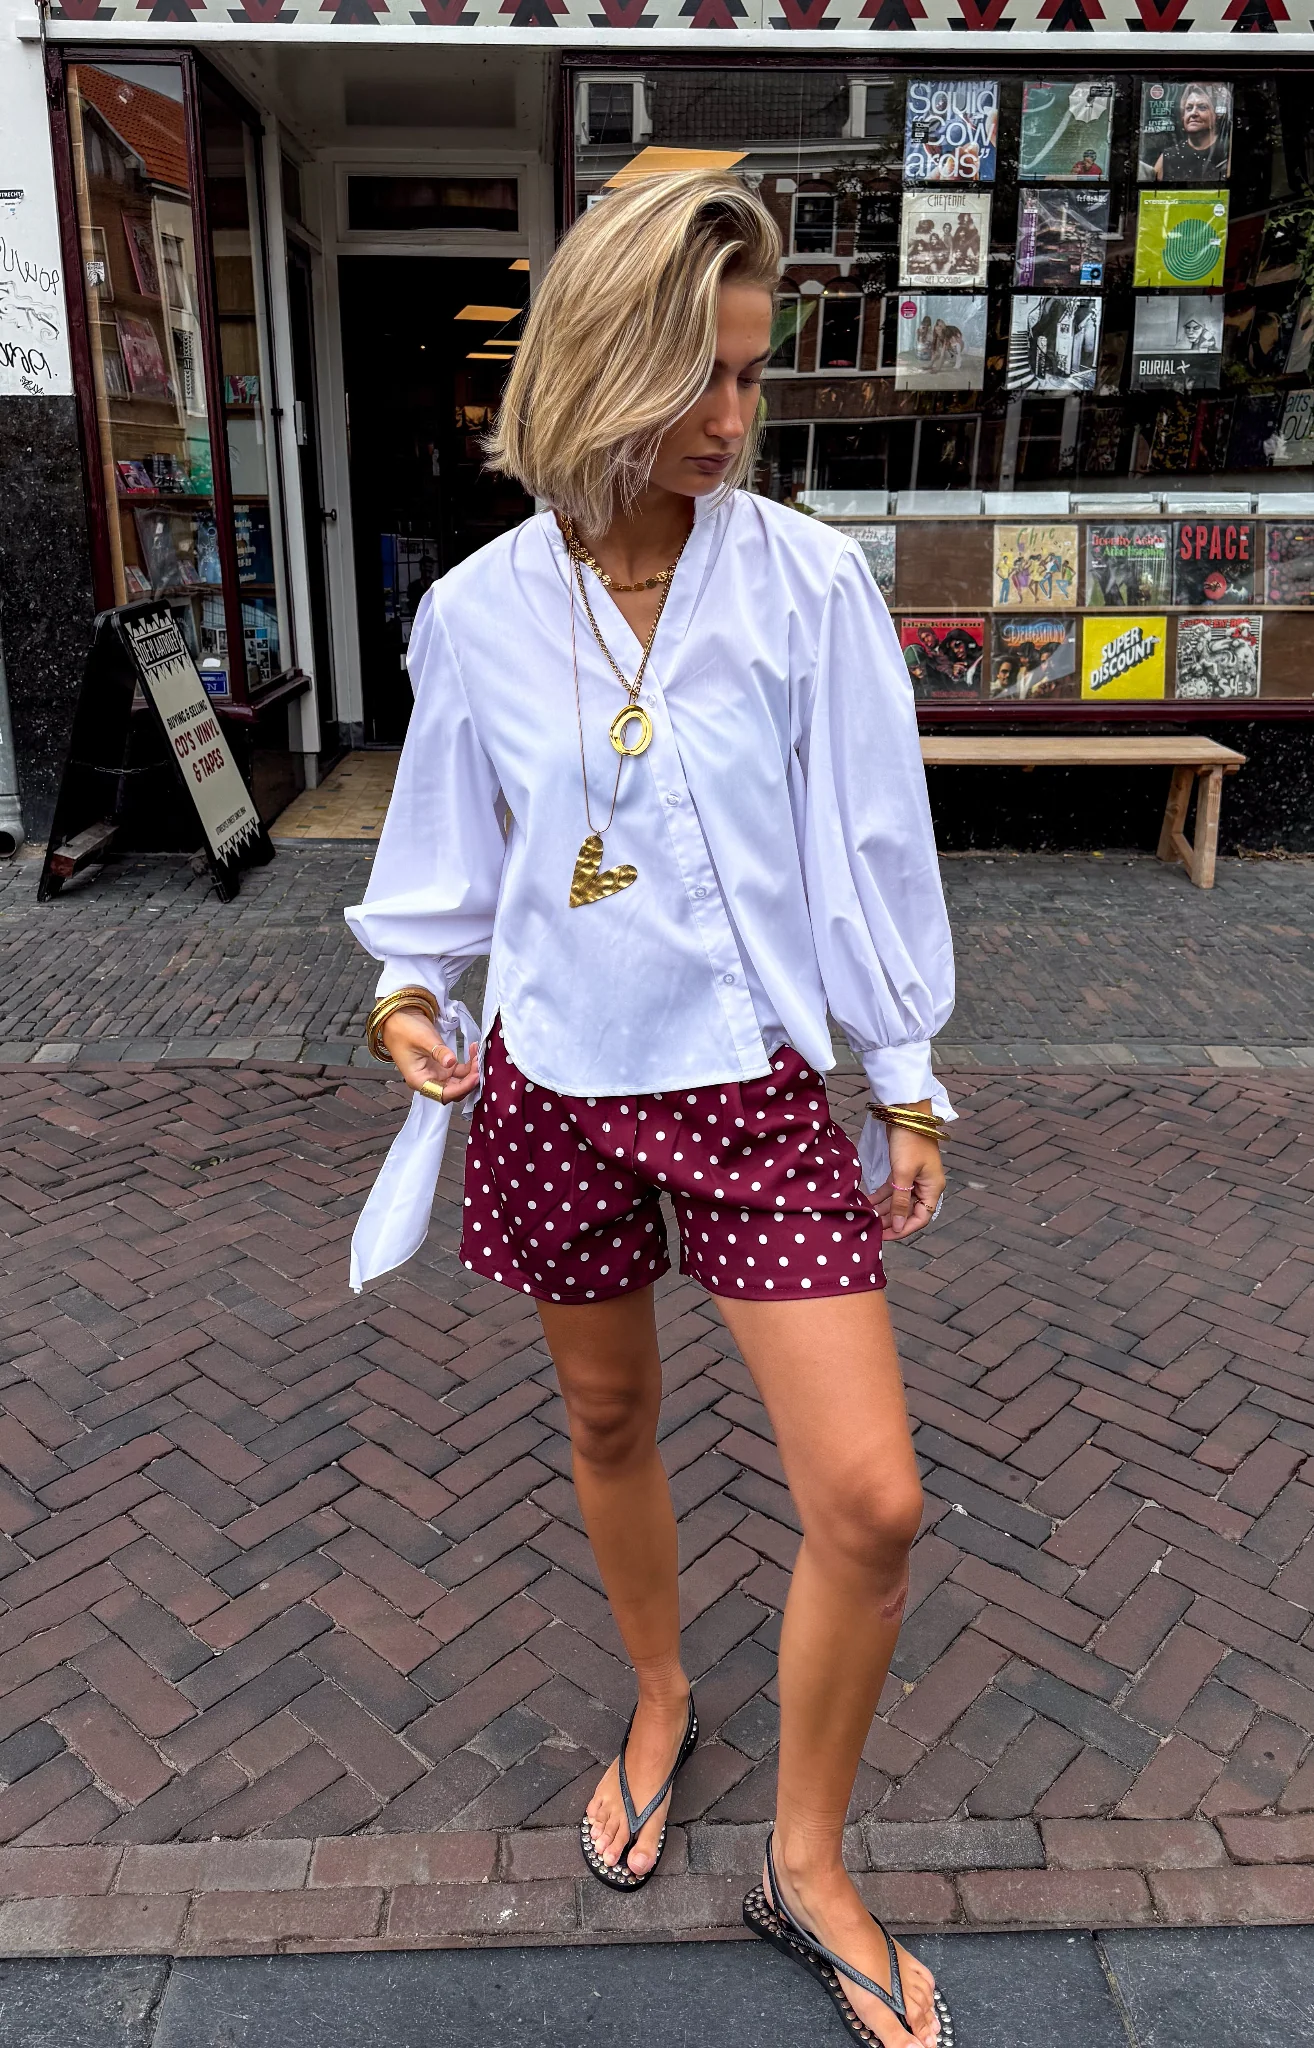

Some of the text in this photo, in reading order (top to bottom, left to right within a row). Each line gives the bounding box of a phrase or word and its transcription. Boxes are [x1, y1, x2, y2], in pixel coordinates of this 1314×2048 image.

[909, 83, 998, 120] Squid
[927, 194, 966, 211] CHEYENNE
[1139, 360, 1176, 375] BURIAL
[1180, 525, 1250, 560] SPACE
[1101, 626, 1143, 663] SUPER
[1090, 636, 1154, 691] DISCOUNT
[166, 710, 187, 730] BUYING
[188, 699, 208, 718] SELLING
[174, 717, 220, 758] CD'S VINYL
[192, 747, 224, 783] & TAPES
